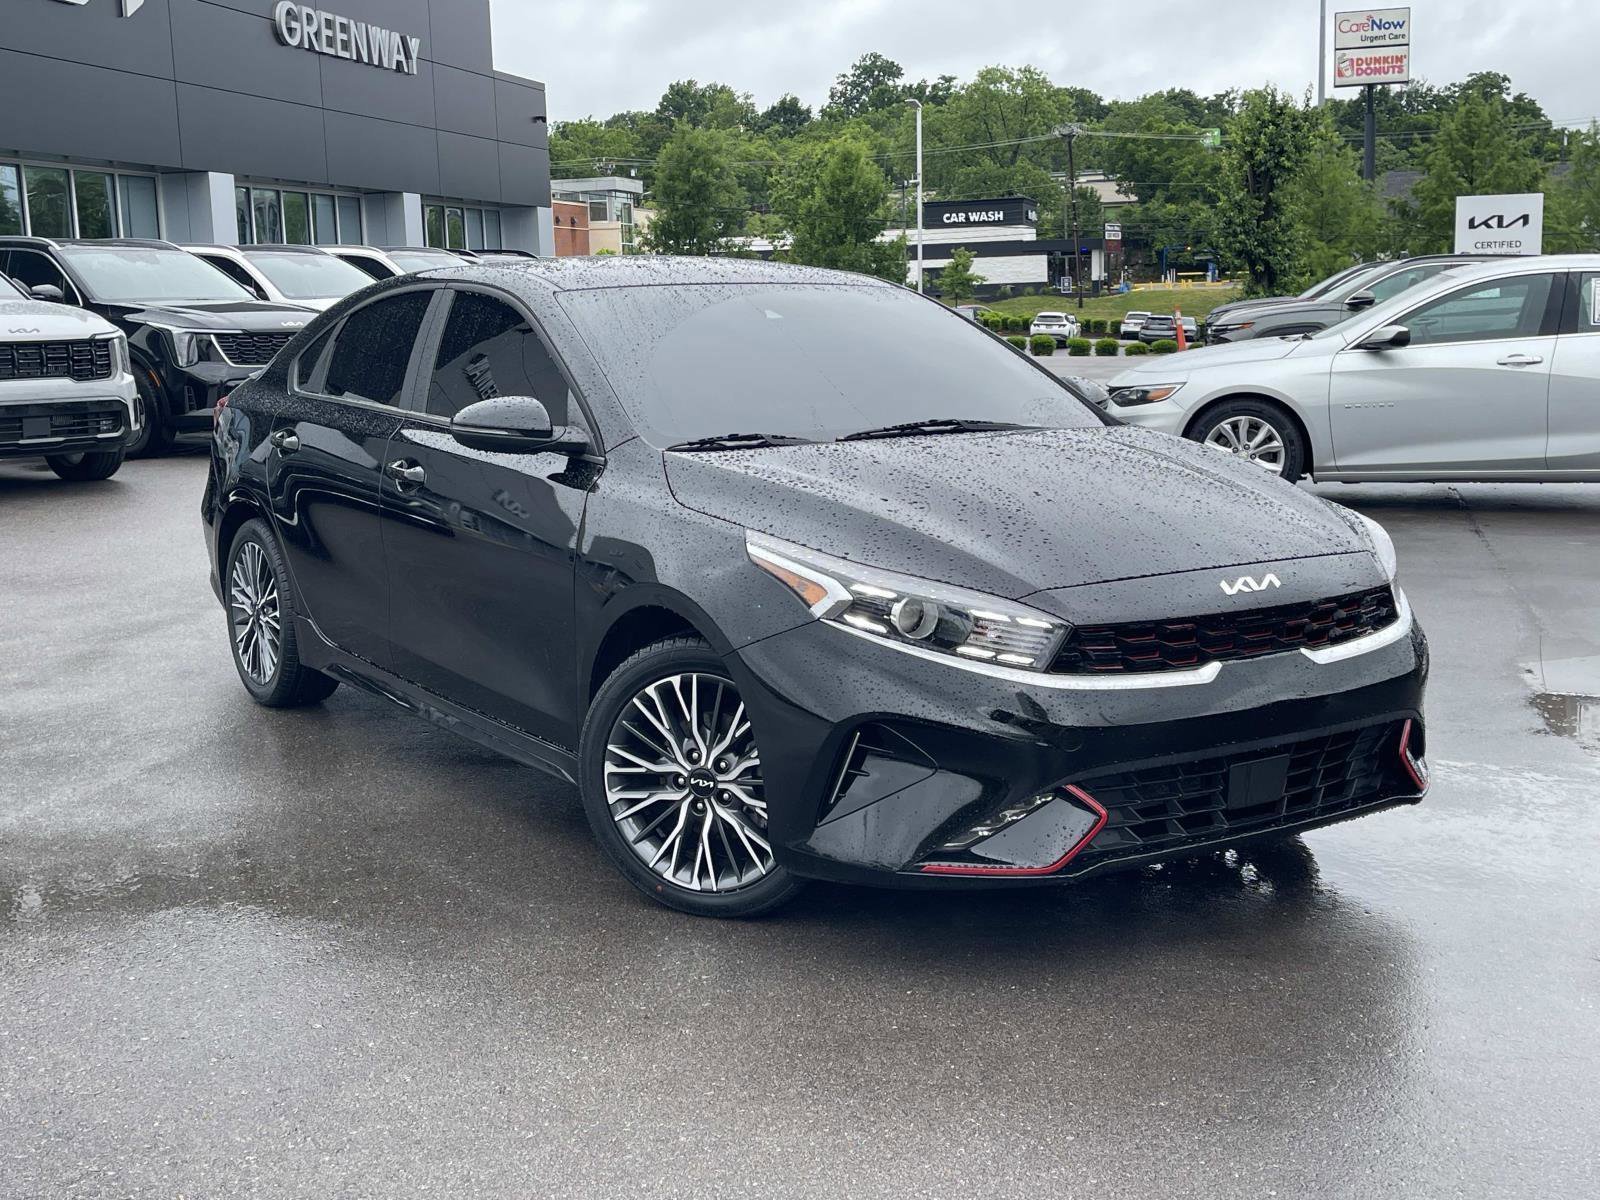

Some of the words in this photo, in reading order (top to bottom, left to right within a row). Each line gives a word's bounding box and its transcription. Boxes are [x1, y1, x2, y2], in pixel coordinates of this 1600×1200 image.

[1338, 17, 1406, 34] CareNow
[274, 0, 420, 75] GREENWAY
[1360, 34, 1387, 43] Urgent
[1388, 32, 1406, 40] Care
[1355, 54, 1407, 67] DUNKIN'
[1355, 65, 1405, 77] DONUTS
[942, 213, 966, 223] CAR
[968, 210, 1004, 223] WASH
[1468, 213, 1530, 230] KIA
[1474, 240, 1522, 250] CERTIFIED
[1219, 573, 1282, 596] KIA
